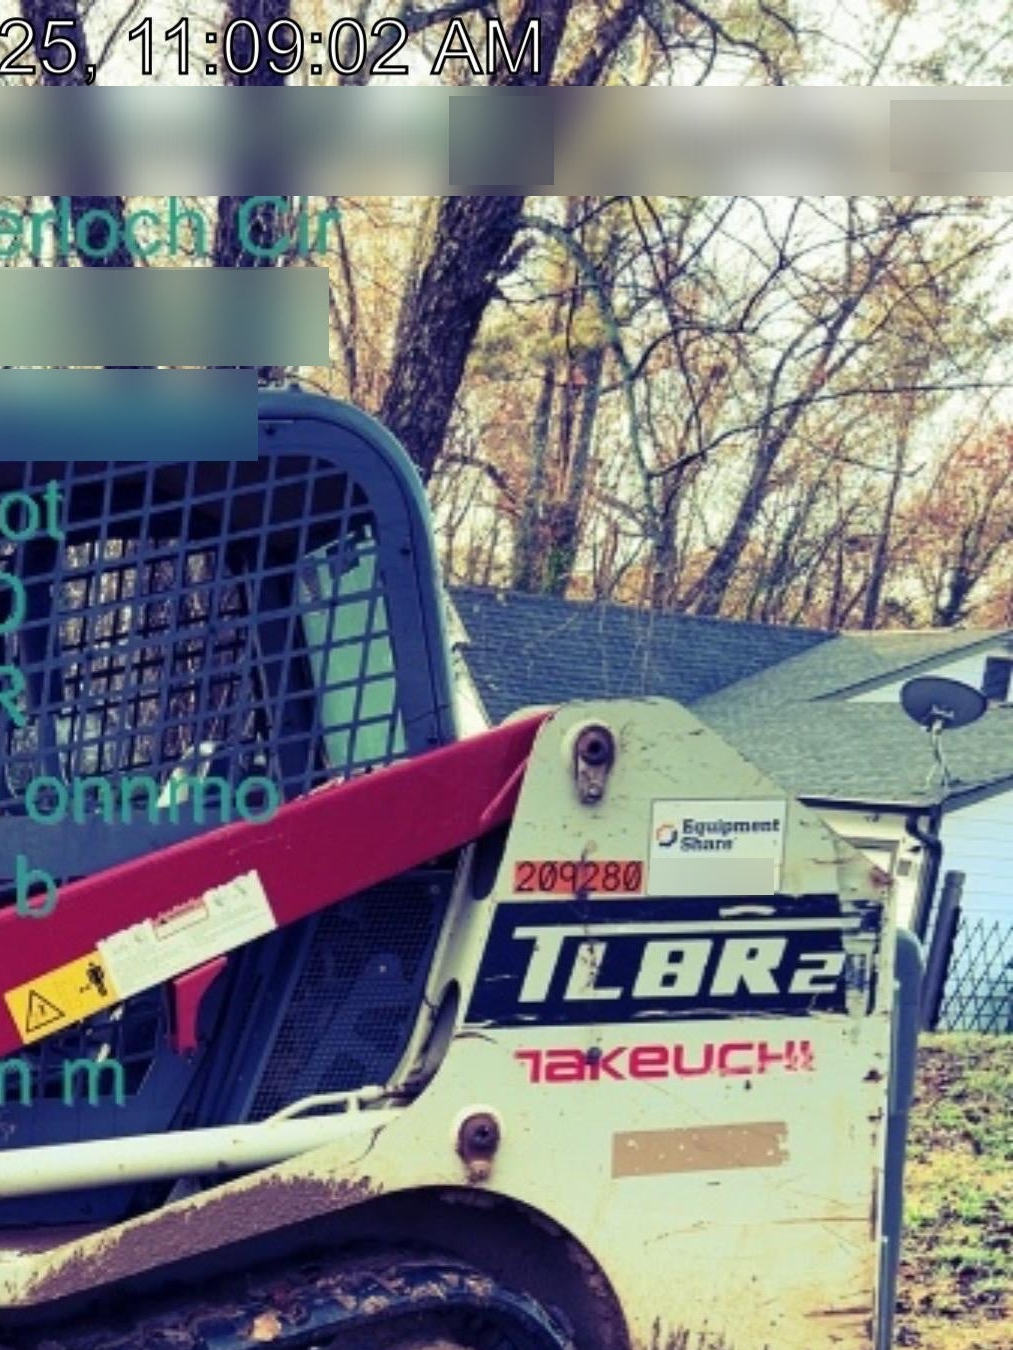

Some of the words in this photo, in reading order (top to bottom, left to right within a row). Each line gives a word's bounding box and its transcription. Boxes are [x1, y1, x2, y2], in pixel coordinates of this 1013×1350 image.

[682, 819, 780, 836] Equipment
[680, 837, 733, 851] Share
[515, 861, 643, 892] 209280
